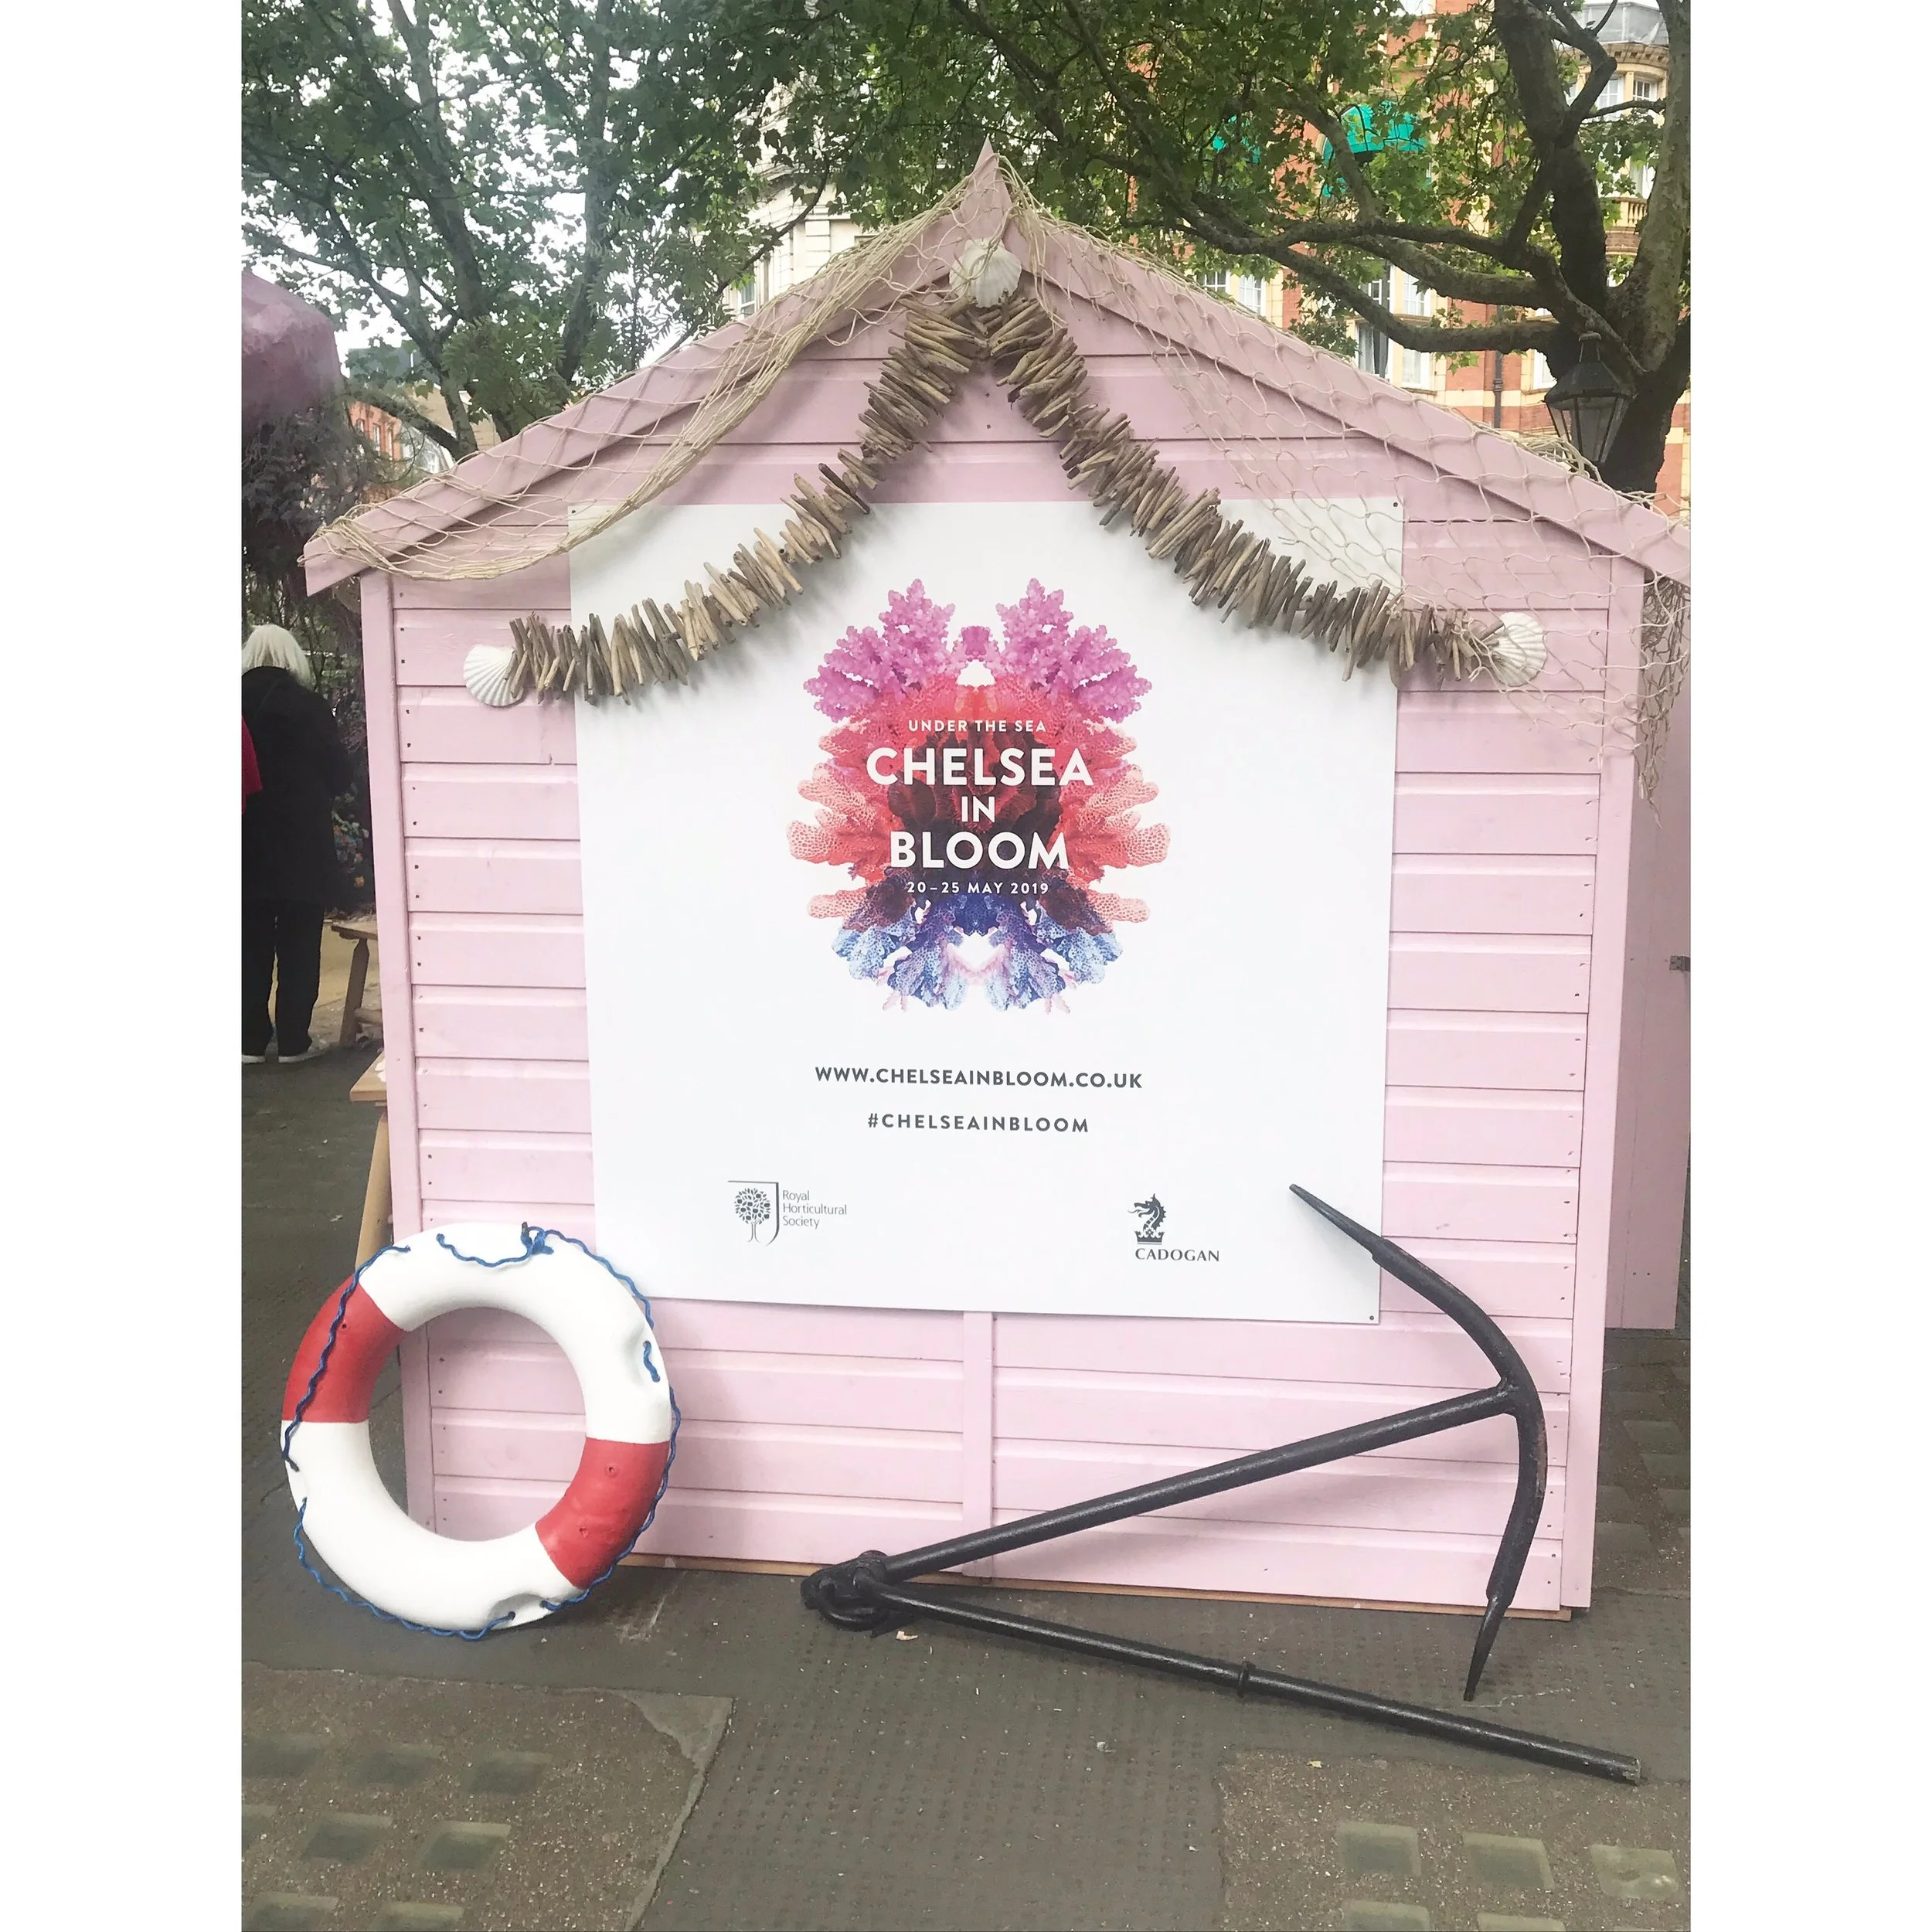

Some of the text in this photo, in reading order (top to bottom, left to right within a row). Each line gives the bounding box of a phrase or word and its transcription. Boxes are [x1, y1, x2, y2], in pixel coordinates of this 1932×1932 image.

[908, 719, 1046, 733] UNDER THE SEA
[866, 747, 1094, 787] CHELSEA
[961, 796, 995, 823] IN
[889, 831, 1069, 869] BLOOM
[968, 882, 1003, 895] MAY
[1010, 882, 1049, 895] 2019
[815, 1066, 1142, 1089] WWW.CHELSEAINBLOOM.CO.UK
[868, 1113, 1089, 1133] #CHELSEAINBLOOM
[782, 1189, 810, 1202] Royal
[782, 1202, 847, 1216] Horticultural
[782, 1216, 820, 1230] Society
[1135, 1248, 1219, 1262] CADOGAN
